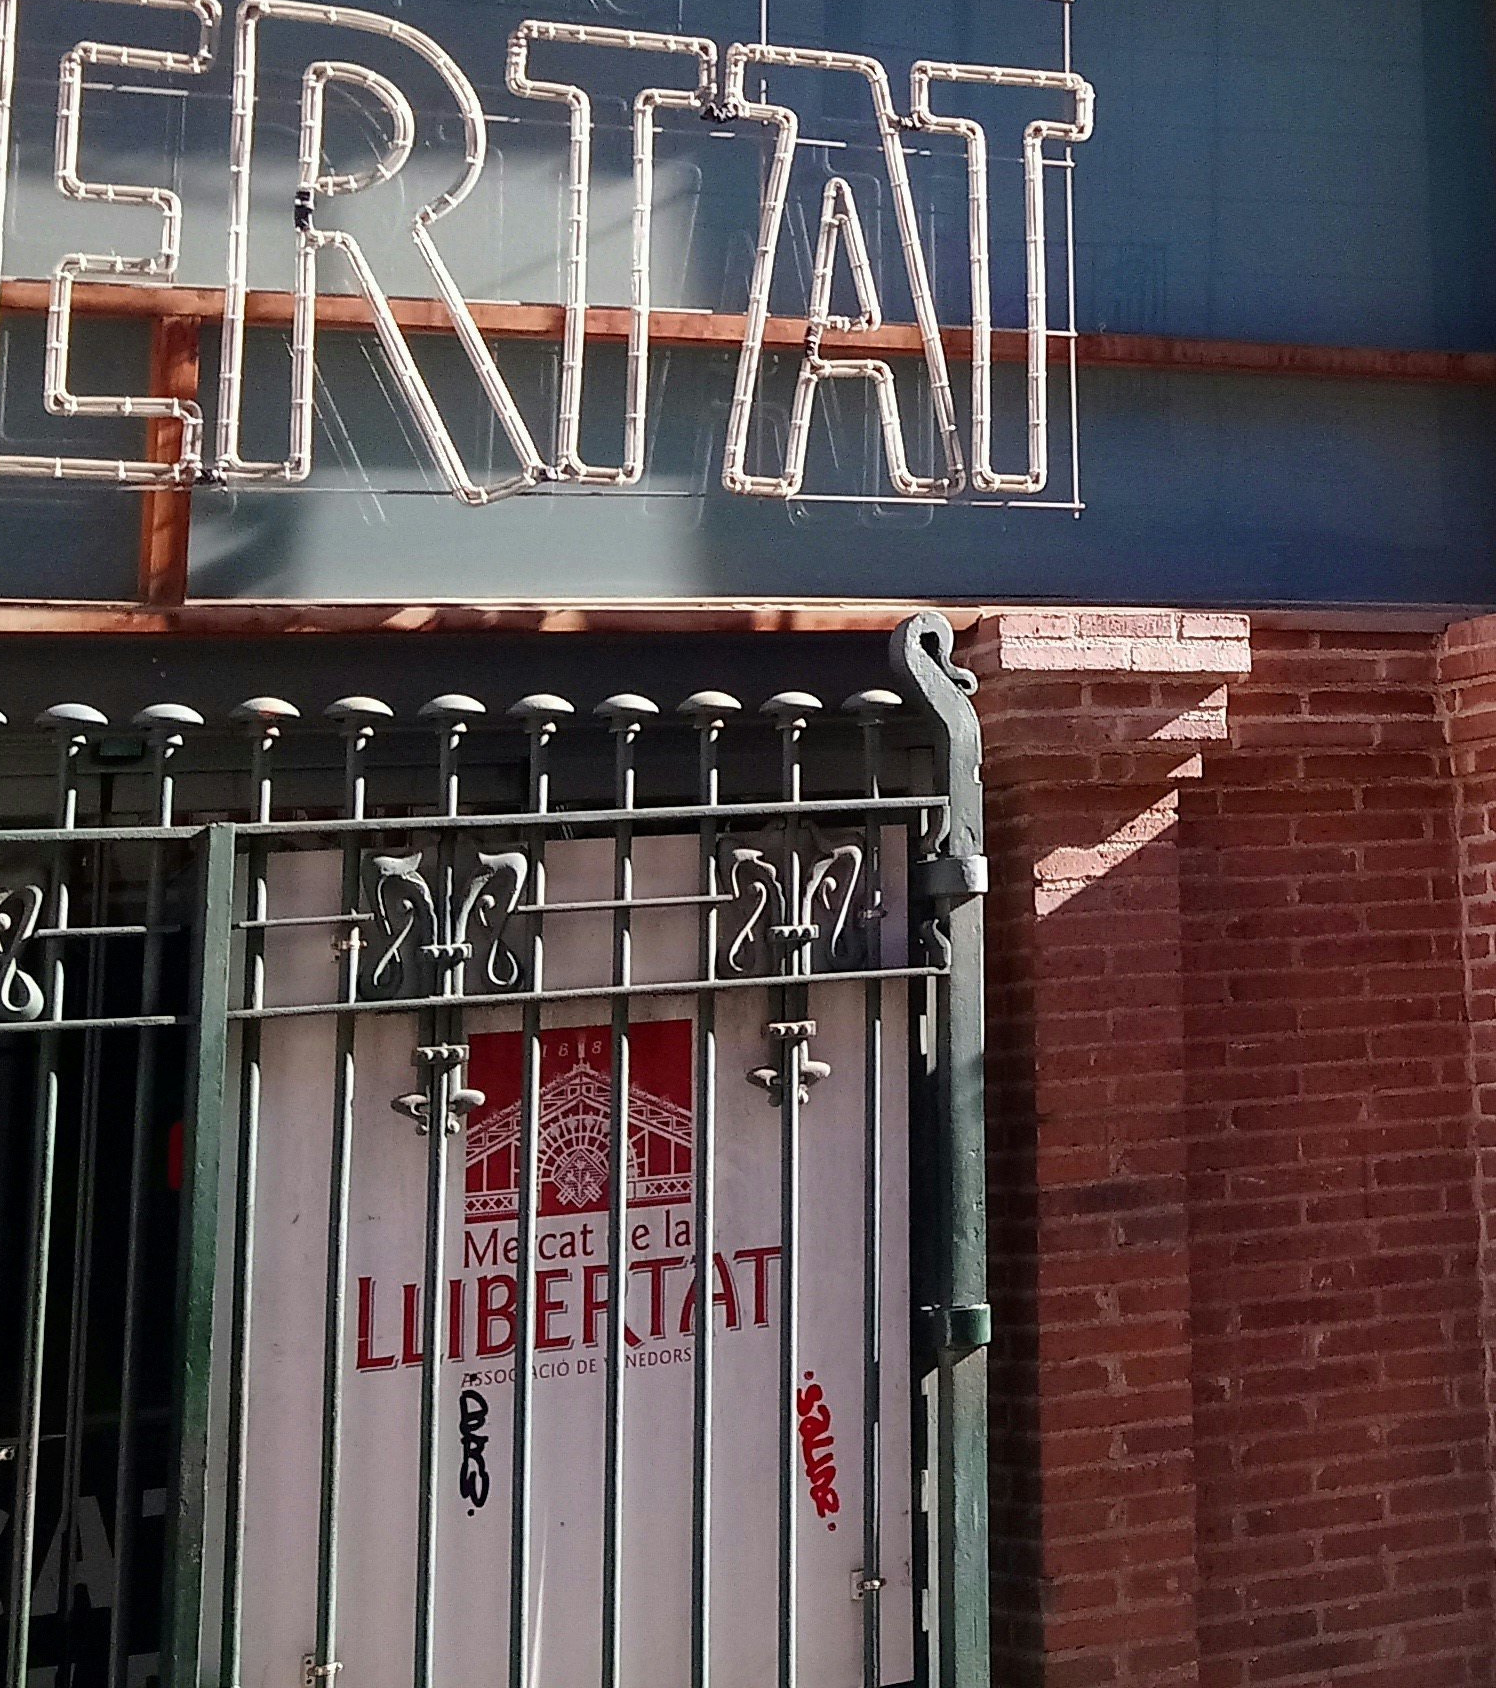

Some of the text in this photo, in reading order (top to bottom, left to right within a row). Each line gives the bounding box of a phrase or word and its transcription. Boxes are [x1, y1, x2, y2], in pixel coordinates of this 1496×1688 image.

[464, 1223, 594, 1269] Mecat
[665, 1209, 691, 1248] la
[577, 1358, 598, 1375] DE
